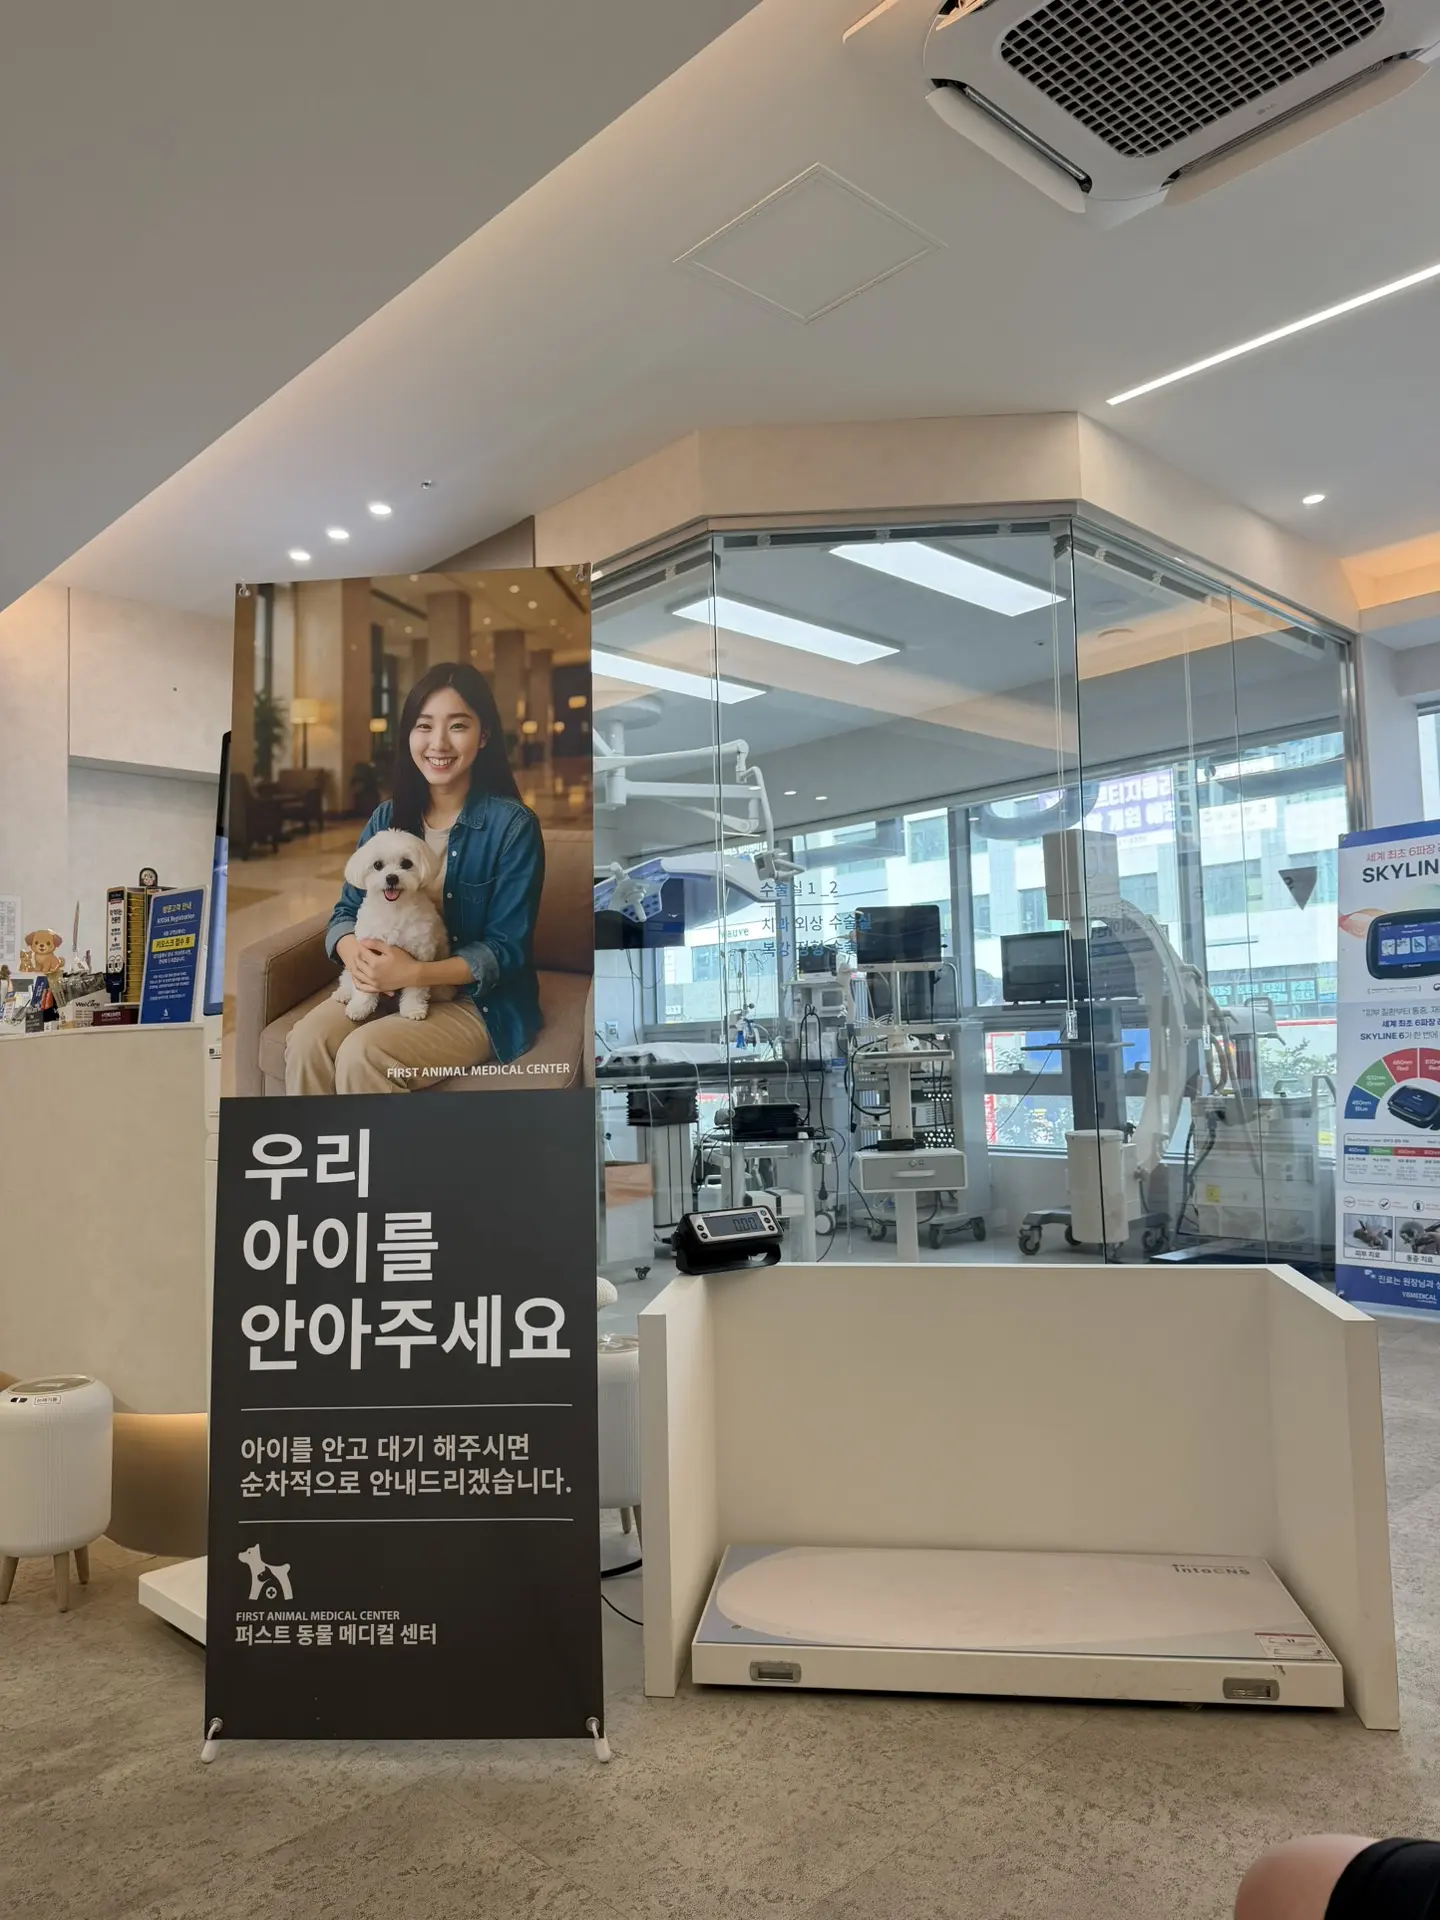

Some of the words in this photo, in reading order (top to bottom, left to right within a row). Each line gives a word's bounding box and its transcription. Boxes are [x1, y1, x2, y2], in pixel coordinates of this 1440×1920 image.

[1366, 851, 1386, 862] 세계
[1387, 848, 1406, 859] 최초
[1409, 844, 1436, 856] 6파장
[1362, 858, 1439, 884] SKYLIN
[760, 881, 802, 898] 수술실
[762, 916, 789, 933] 치과
[795, 915, 823, 932] 외상
[156, 939, 174, 948] 키오스크
[1382, 1019, 1397, 1028] 세계
[1398, 1019, 1413, 1027] 최초
[1414, 1018, 1435, 1027] 6파장
[1360, 1032, 1397, 1041] SKYLINE
[387, 1067, 420, 1079] FIRST
[421, 1066, 469, 1077] ANIMAL
[471, 1064, 524, 1076] MEDICAL
[526, 1063, 571, 1075] CENTER
[245, 1128, 370, 1200] 우리
[243, 1211, 439, 1285] 아이를
[1378, 1275, 1401, 1286] 진료는
[1403, 1277, 1434, 1289] 원장님과
[241, 1294, 571, 1370] 안아주세요
[240, 1436, 313, 1465] 아이를
[321, 1436, 369, 1463] 안고
[378, 1435, 425, 1462] 대기
[433, 1433, 530, 1462] 해주시면
[240, 1469, 361, 1498] 순차적으로
[370, 1467, 572, 1496] 안내드리겠습니다.
[236, 1611, 265, 1621] FIRST
[267, 1611, 308, 1621] ANIMAL
[310, 1611, 358, 1621] MEDICAL
[359, 1610, 400, 1621] CENTER
[235, 1624, 291, 1646] 퍼스트
[296, 1624, 333, 1646] 동물
[339, 1624, 394, 1646] 메디컬
[400, 1623, 437, 1645] 센터
